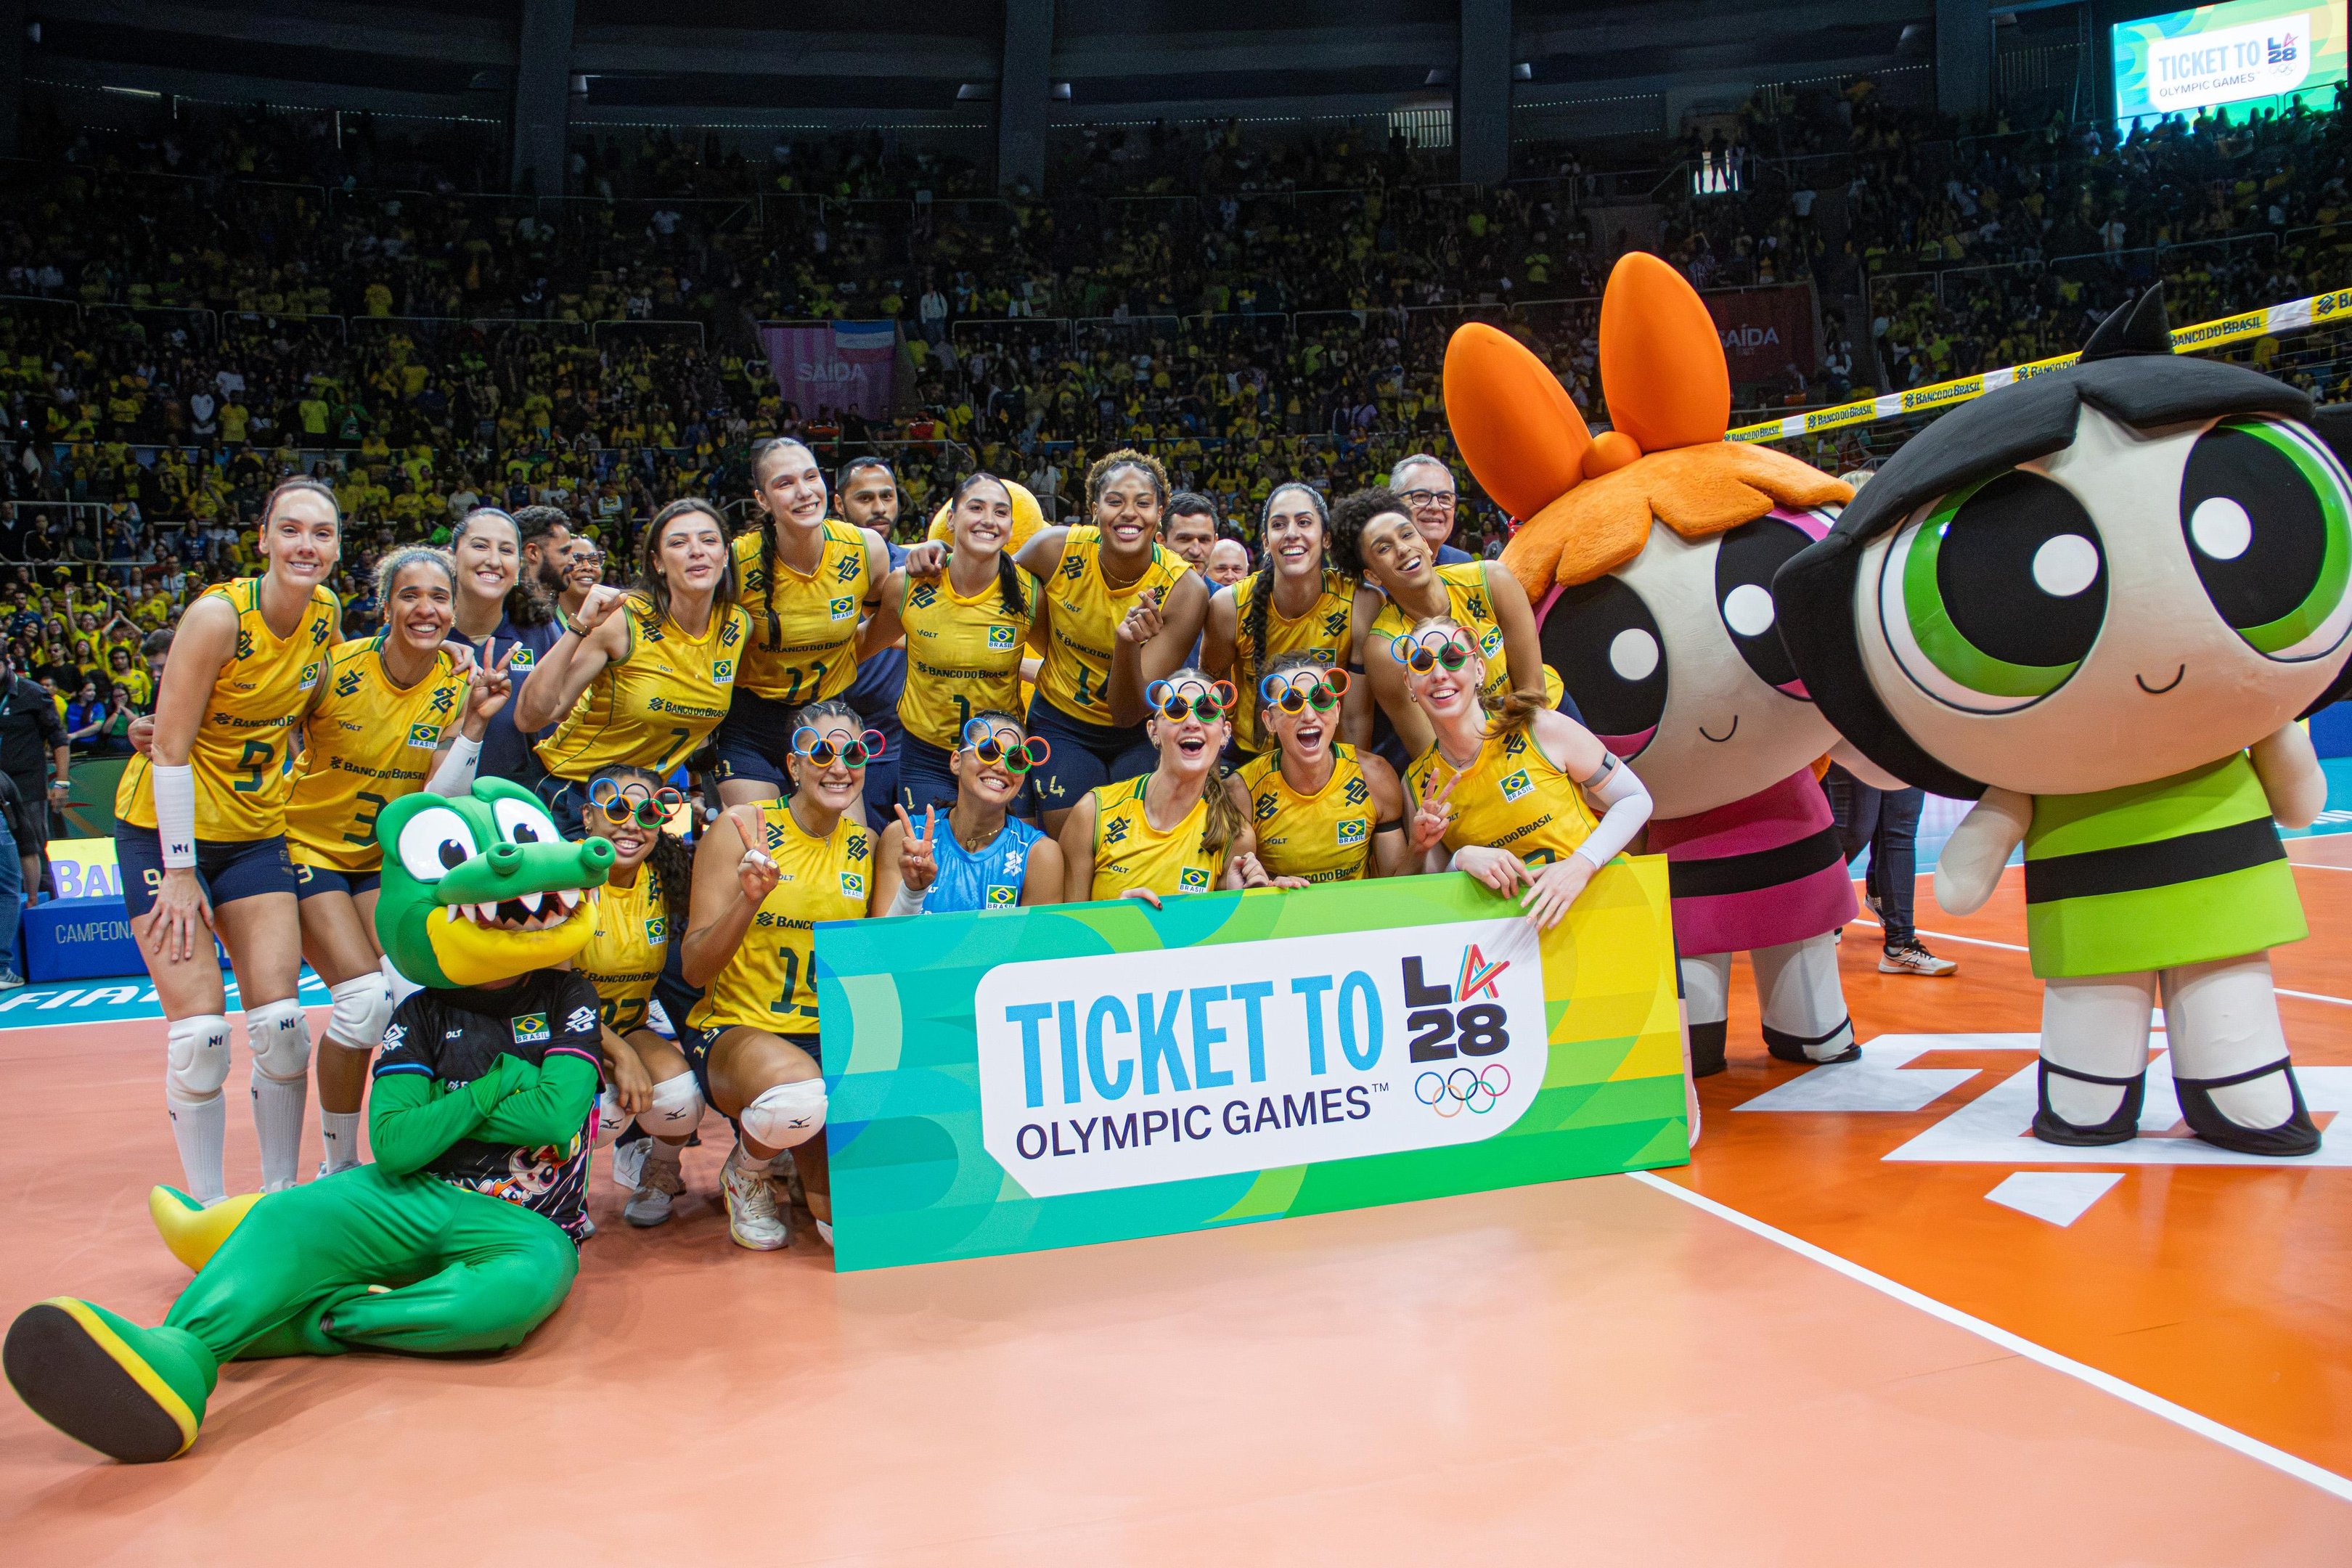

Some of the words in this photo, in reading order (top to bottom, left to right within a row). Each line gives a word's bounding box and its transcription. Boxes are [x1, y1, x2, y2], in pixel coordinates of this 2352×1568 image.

[2267, 33, 2298, 50] LA
[2158, 46, 2229, 81] TICKET
[2234, 41, 2260, 68] TO
[2268, 47, 2297, 64] 28
[2160, 81, 2210, 97] OLYMPIC
[2170, 330, 2205, 346] BANCO
[2207, 326, 2221, 339] DO
[2222, 317, 2261, 335] BRASIL
[796, 355, 867, 382] SAÍDA
[1916, 389, 1943, 404] BANCO
[1943, 388, 1953, 399] DO
[1953, 382, 1980, 396] BRASIL
[1818, 413, 1841, 425] BANCO
[1850, 405, 1873, 417] BRASIL
[1731, 431, 1751, 441] BANCO
[1751, 430, 1760, 438] DO
[1760, 425, 1780, 437] BRASIL
[832, 611, 853, 620] BRASIL
[917, 629, 939, 638] VOLT
[1064, 636, 1095, 656] BANCO
[928, 666, 963, 679] BANCO
[964, 670, 977, 679] DO
[786, 661, 827, 705] 11
[665, 701, 694, 715] BANCO
[338, 720, 363, 732] VOLT
[950, 694, 971, 744] 1
[407, 739, 437, 748] BRASIL
[654, 727, 690, 772] 7
[234, 739, 274, 792] 9
[391, 768, 425, 780] BRASIL
[1034, 775, 1066, 799] 14
[1507, 786, 1534, 802] BRASIL
[904, 786, 915, 809] 1
[343, 791, 388, 847] 3
[1505, 831, 1519, 844] DO
[1516, 813, 1553, 837] BRASIL
[1339, 835, 1365, 844] BRASIL
[1319, 871, 1334, 881] DO
[1335, 862, 1362, 880] BRASIL
[843, 889, 862, 898] BRASIL
[1180, 883, 1205, 893] BRASIL
[588, 973, 626, 983] BANCO
[1401, 943, 1511, 1008] LA
[385, 989, 394, 1000] N
[516, 1032, 549, 1042] BRASIL
[1005, 980, 1274, 1108] TICKET
[1291, 970, 1384, 1076] TO
[1407, 1003, 1511, 1063] 28
[1016, 1105, 1212, 1160] OLYMPIC
